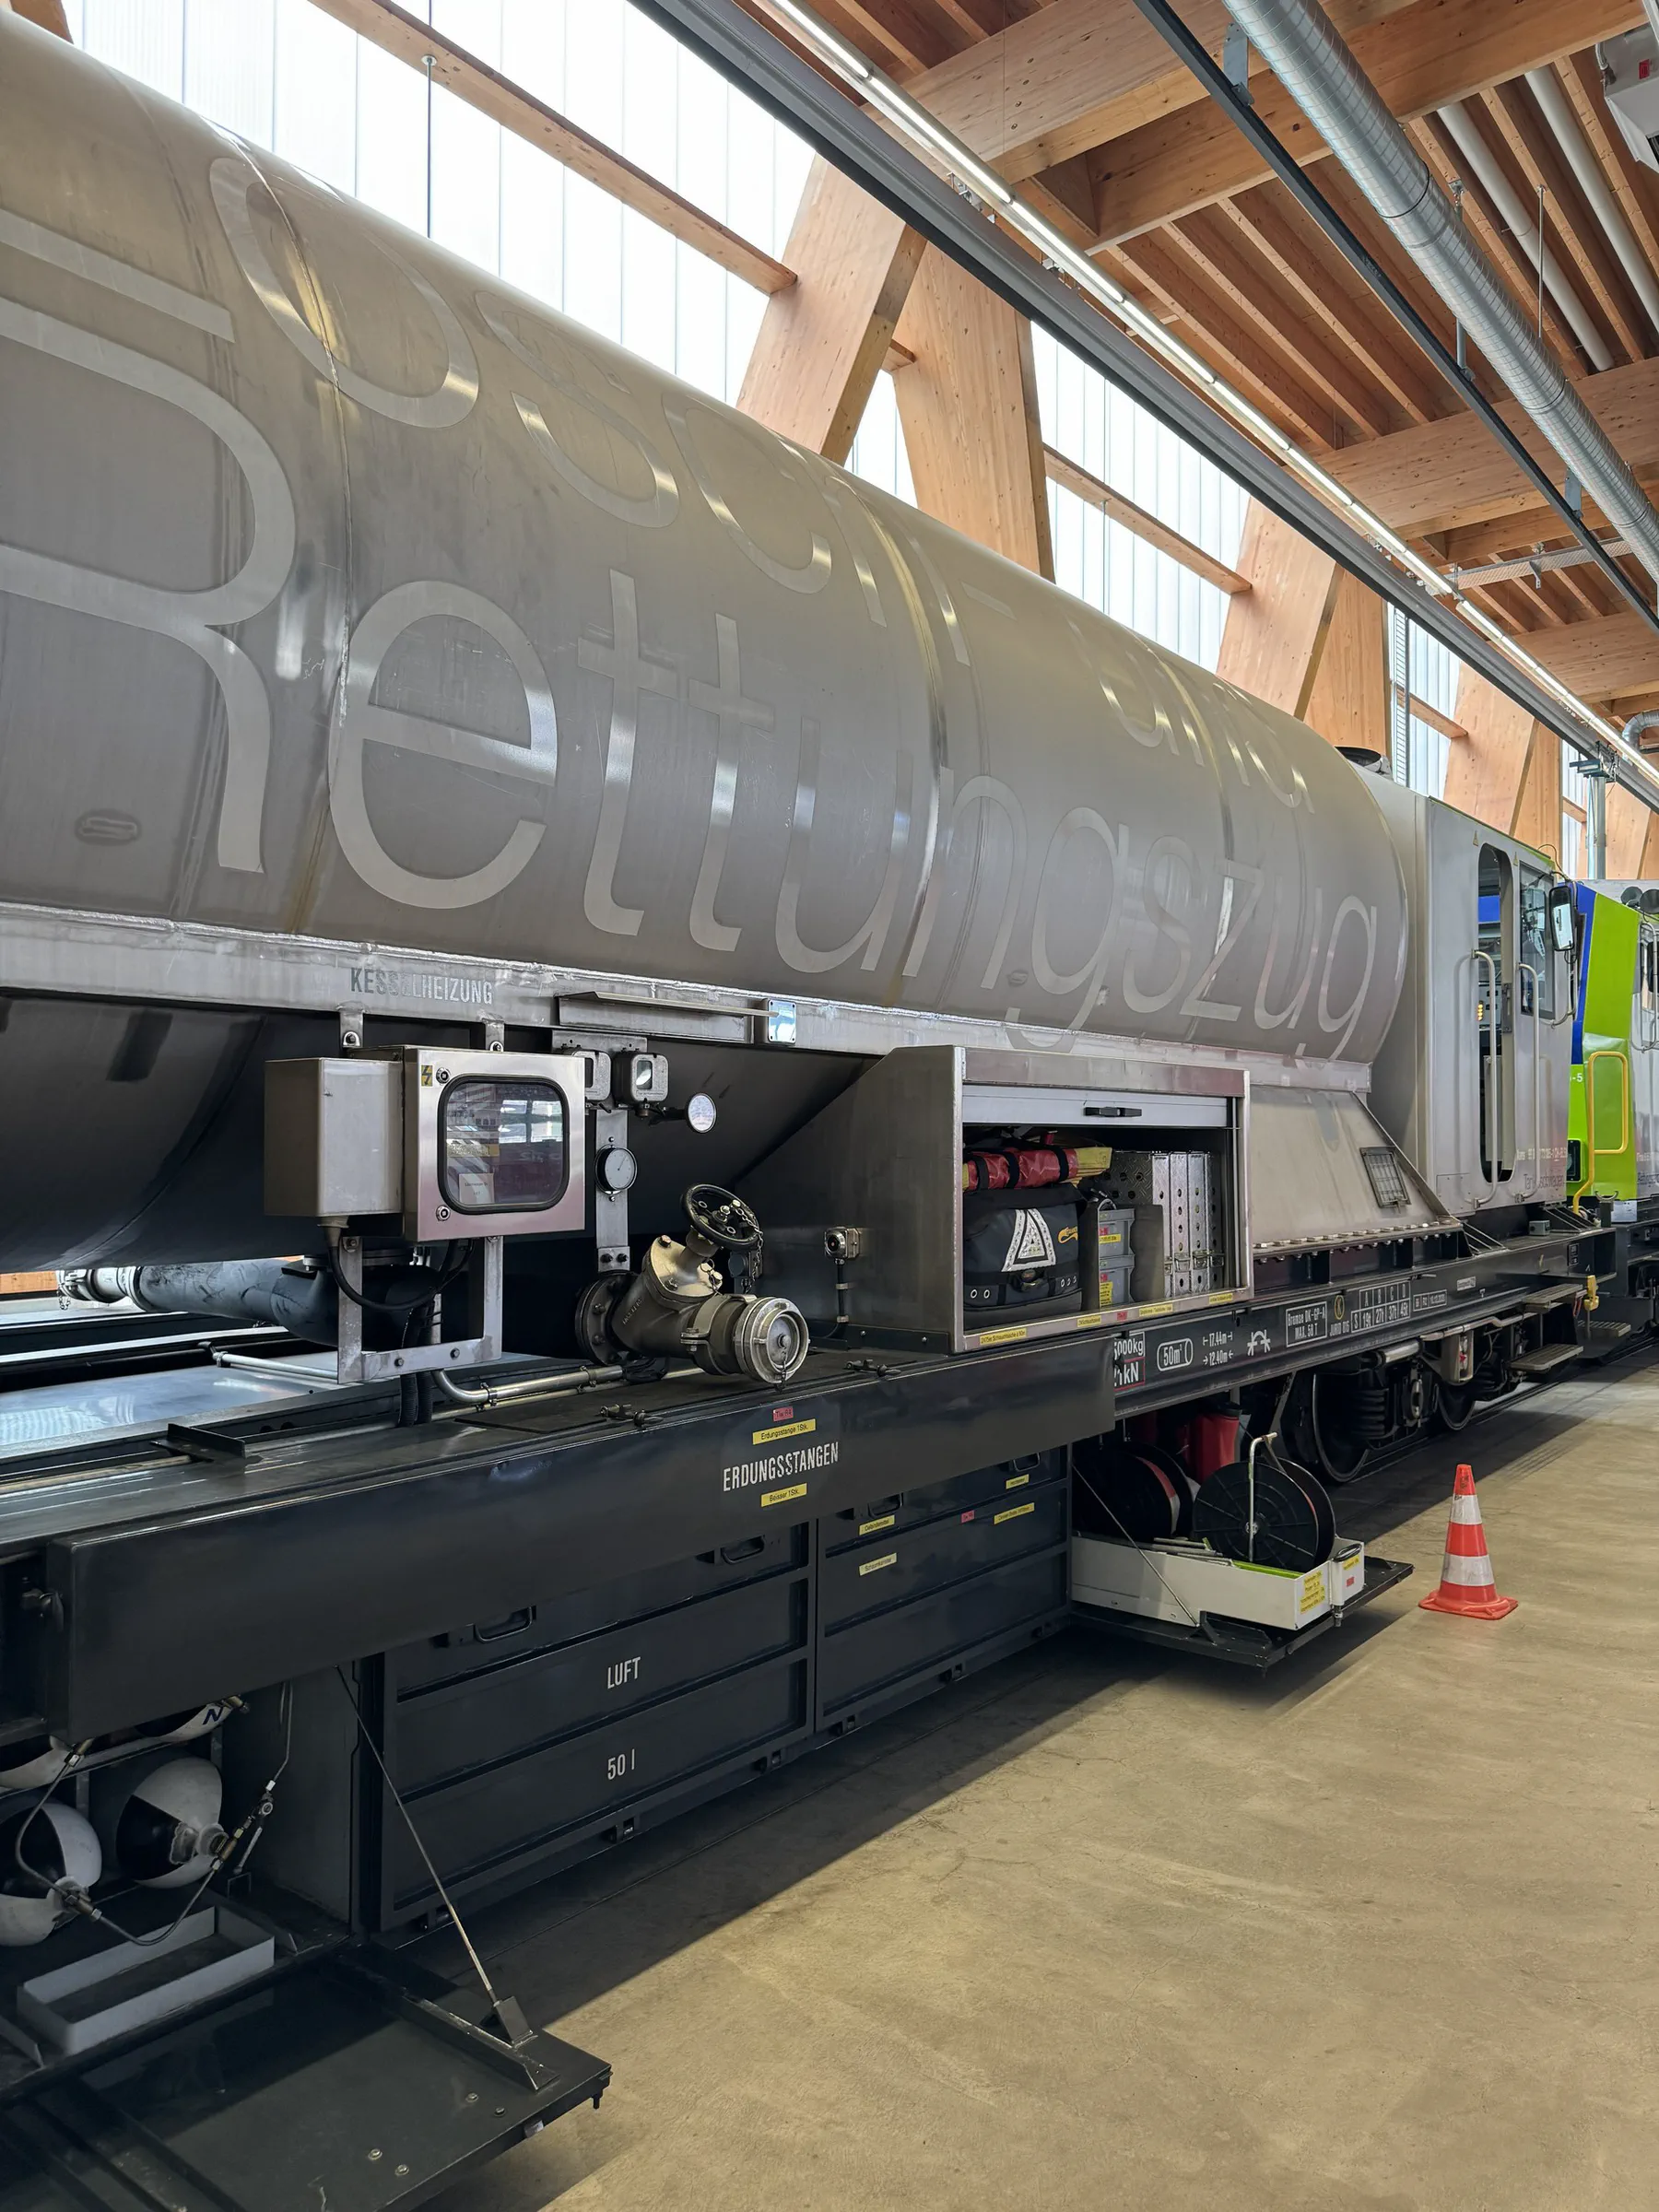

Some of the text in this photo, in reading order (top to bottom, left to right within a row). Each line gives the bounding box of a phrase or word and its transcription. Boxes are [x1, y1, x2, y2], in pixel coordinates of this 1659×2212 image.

[350, 968, 493, 1005] KESSELHEIZUNG
[1288, 1312, 1304, 1326] Bremse
[1354, 1313, 1359, 1329] S
[1208, 1331, 1227, 1347] 17.44m
[1208, 1349, 1228, 1367] 12.40m
[761, 1423, 809, 1441] Erdungsstange 1Stk.
[723, 1441, 839, 1492] ERDUNGSSTANGEN
[769, 1490, 787, 1502] Beisser
[607, 1656, 641, 1689] LUFT
[607, 1753, 626, 1780] 50
